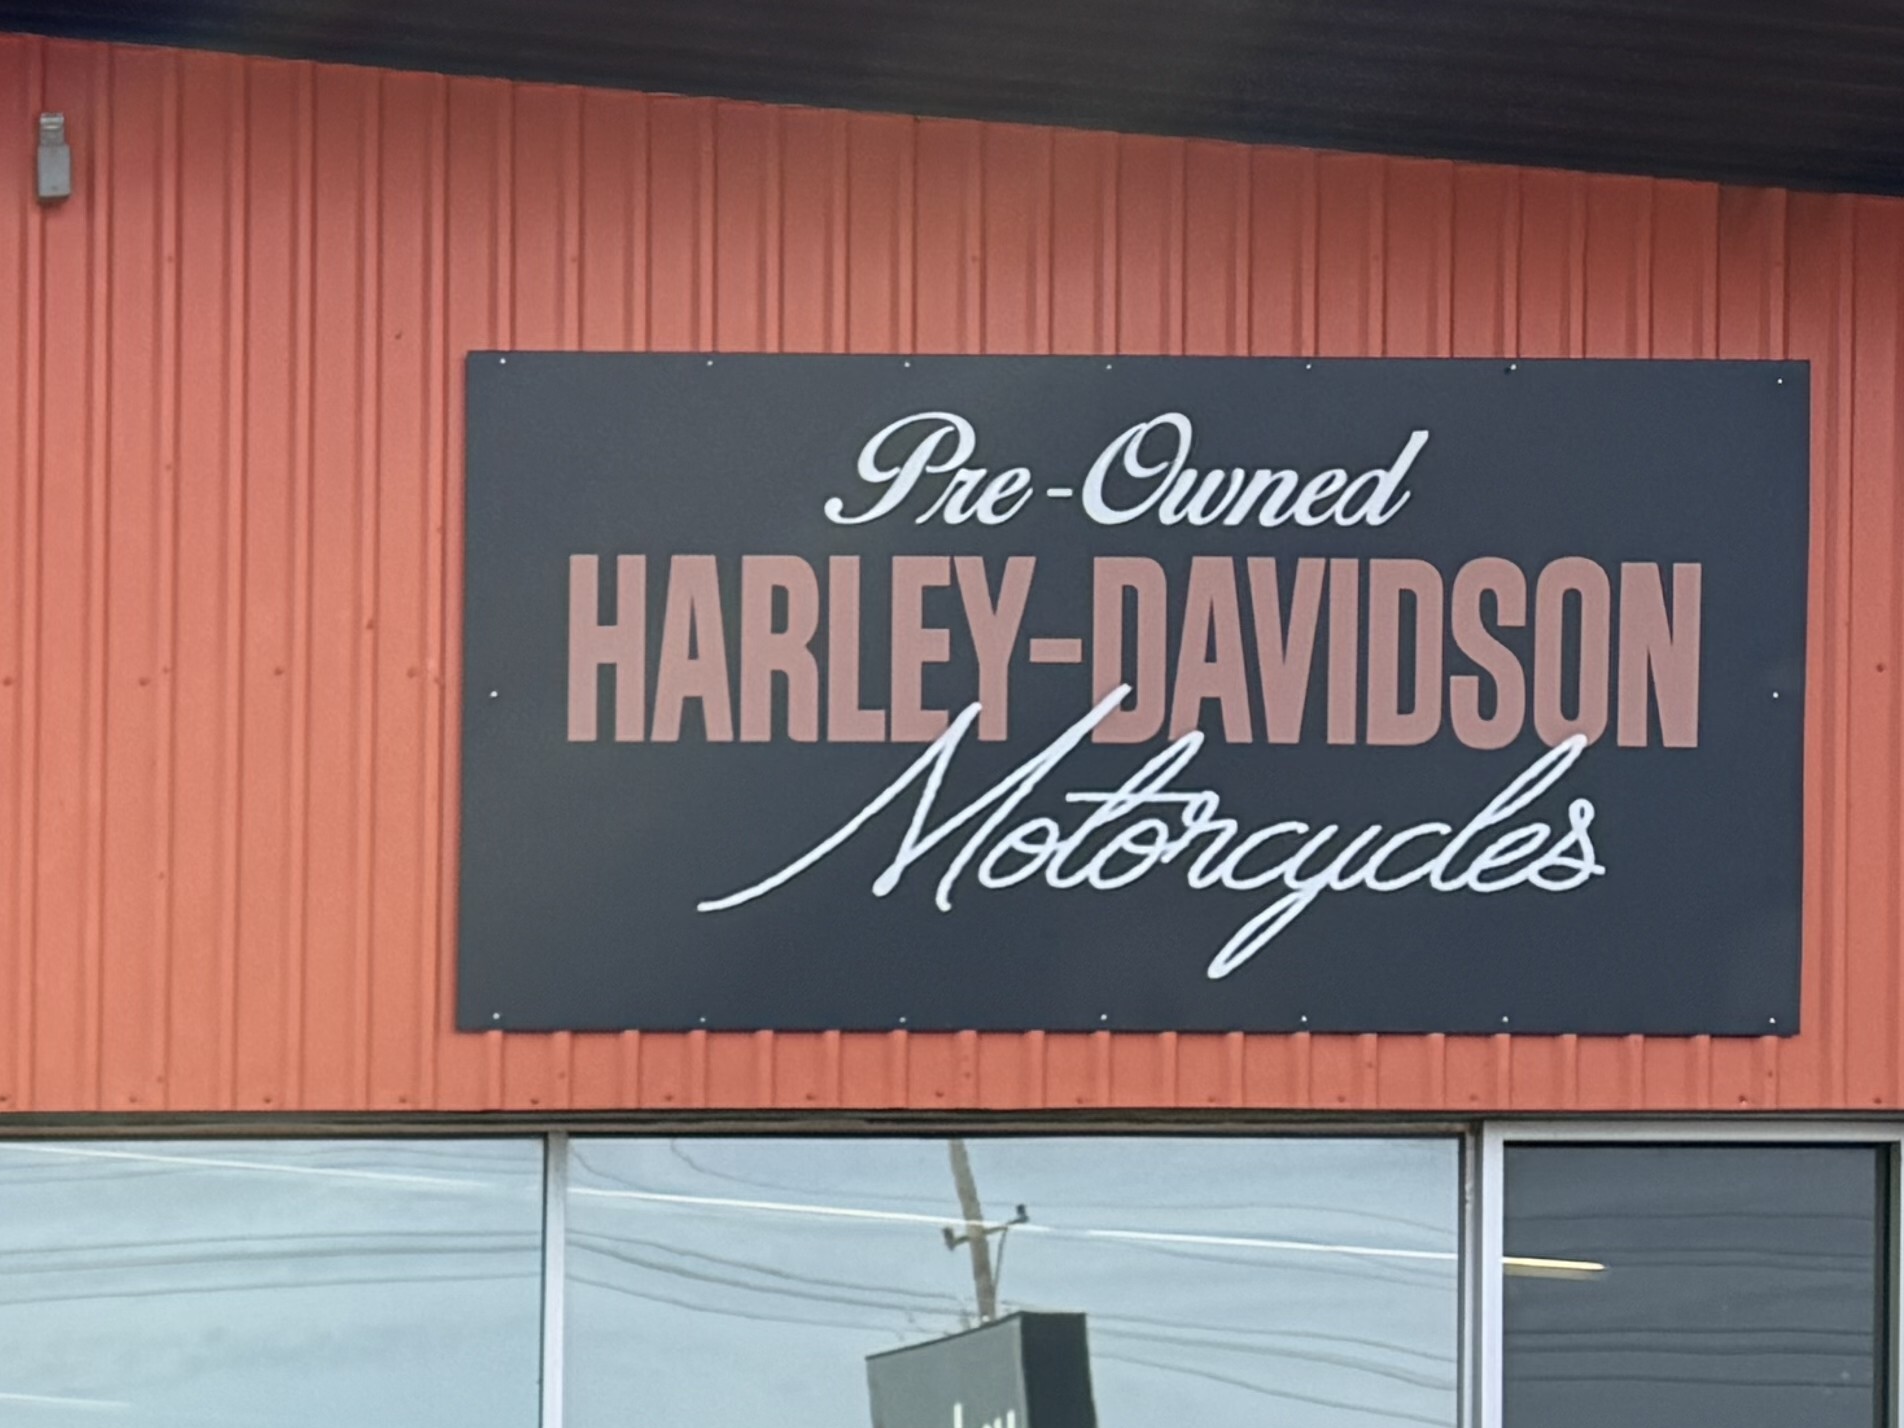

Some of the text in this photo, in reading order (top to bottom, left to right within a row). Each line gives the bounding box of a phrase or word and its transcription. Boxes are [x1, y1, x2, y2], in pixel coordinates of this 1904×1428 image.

[825, 411, 1430, 528] Pre-Owned
[567, 553, 1703, 750] HARLEY-DAVIDSON
[697, 684, 1606, 980] Motorcycles
